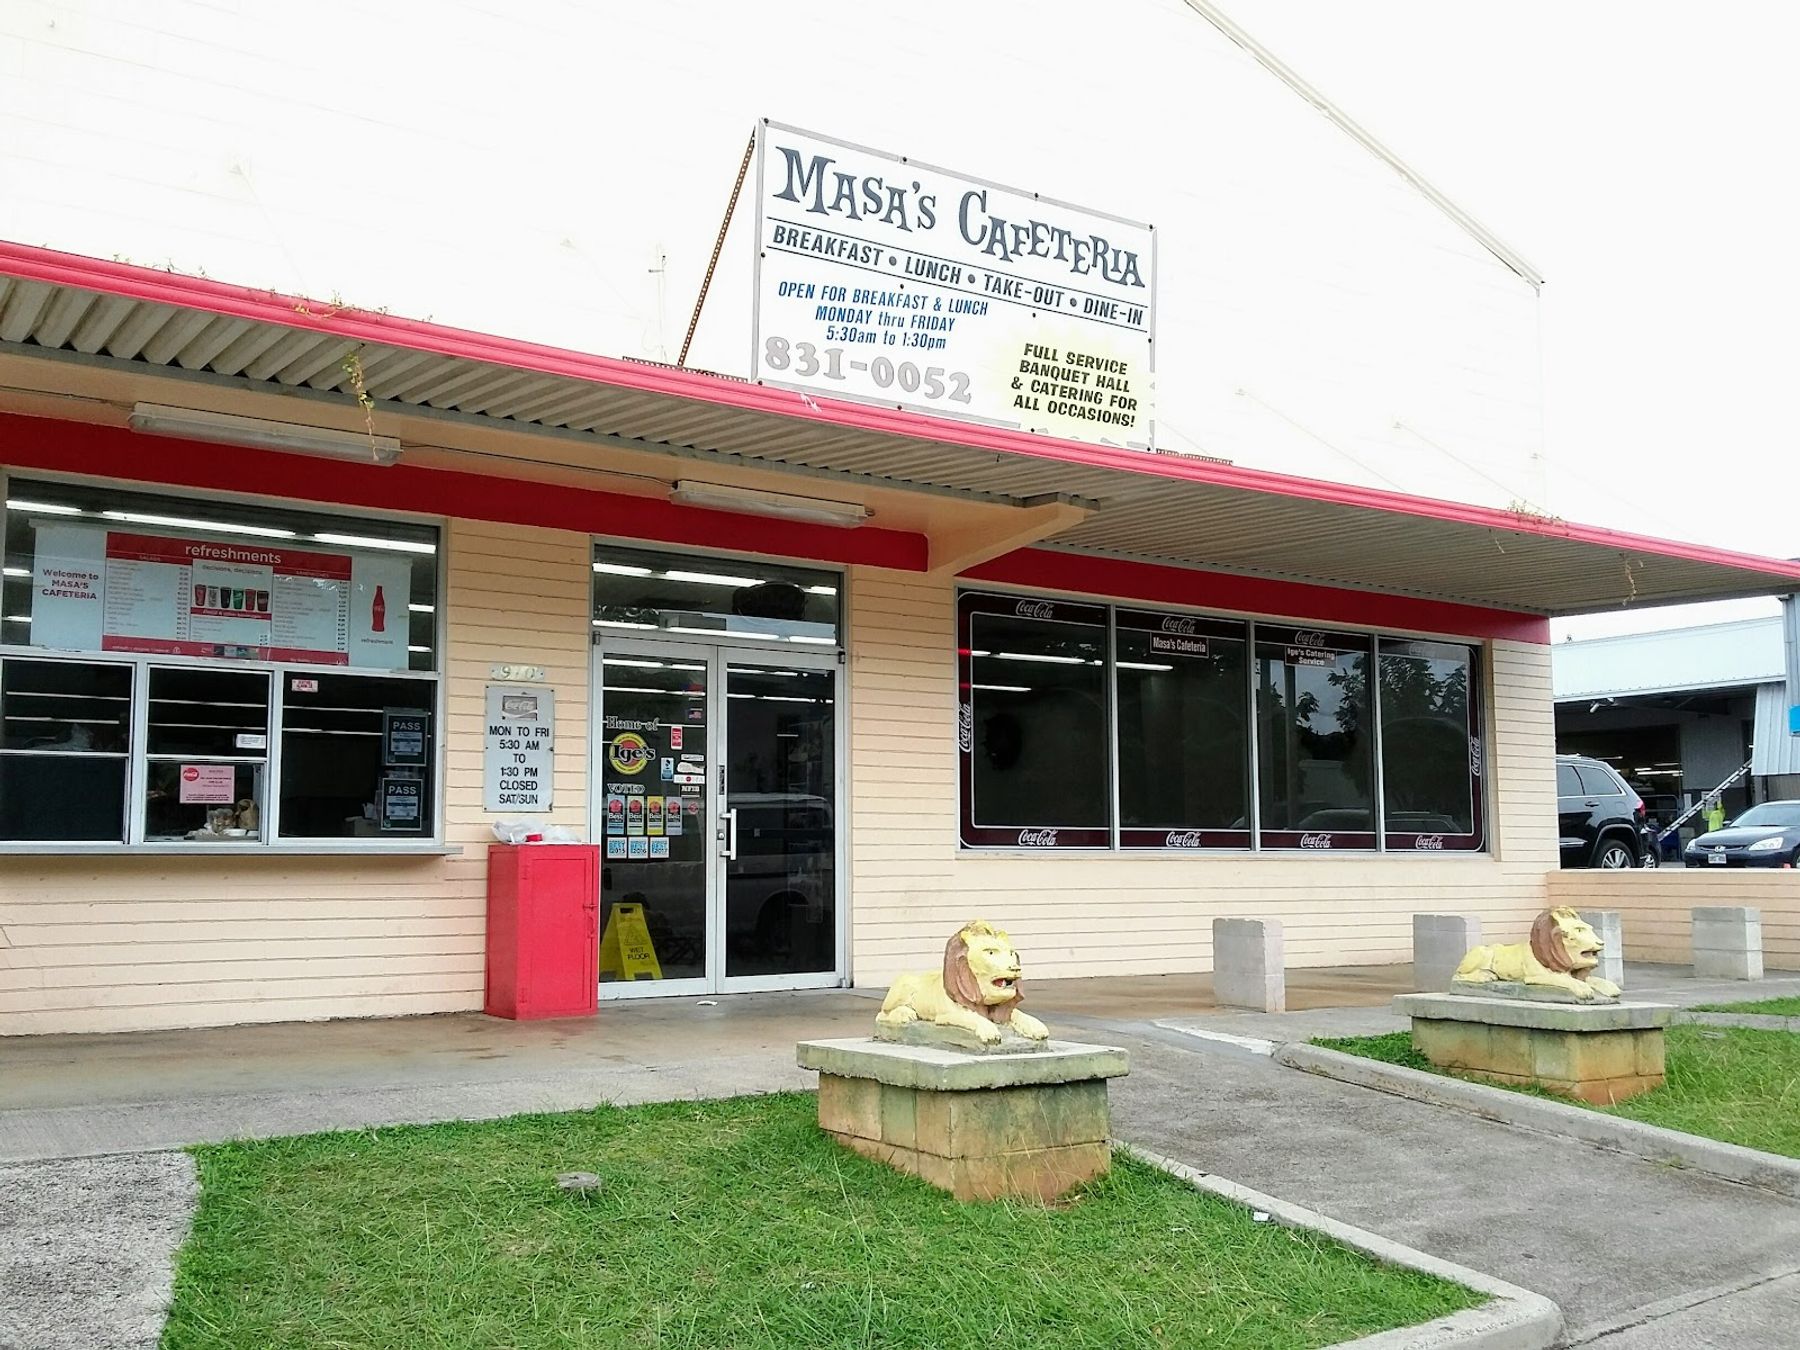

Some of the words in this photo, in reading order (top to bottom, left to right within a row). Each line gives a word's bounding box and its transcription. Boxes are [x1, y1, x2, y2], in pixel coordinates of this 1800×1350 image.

[772, 146, 937, 233] MASA'S
[958, 189, 1146, 288] CAFETERIA
[772, 224, 884, 267] BREAKFAST
[904, 256, 962, 285] LUNCH
[983, 273, 1065, 308] TAKE-OUT
[1083, 296, 1144, 326] DINE-IN
[778, 281, 816, 300] OPEN
[821, 285, 847, 302] FOR
[852, 288, 928, 311] BREAKFAST
[933, 296, 942, 312] &
[948, 298, 989, 317] LUNCH
[815, 304, 873, 326] MONDAY
[878, 311, 905, 328] thru
[910, 314, 956, 332] FRIDAY
[826, 325, 877, 345] 5:30am
[883, 330, 896, 346] to
[902, 332, 947, 351] 1:30pm
[1023, 342, 1059, 362] FULL
[1065, 351, 1128, 376] SERVICE
[765, 336, 972, 405] 831-0052
[1019, 359, 1091, 385] BANQUET
[1096, 374, 1130, 393] HALL
[1011, 376, 1023, 390] &
[1030, 378, 1103, 405] CATERING
[1109, 394, 1138, 411] FOR
[1013, 394, 1040, 411] ALL
[1047, 400, 1136, 428] OCCASIONS!
[185, 544, 282, 564] refreshments
[42, 568, 87, 580] Welcome
[88, 570, 99, 581] to
[51, 579, 89, 590] MASA'S
[41, 588, 97, 600] CAFETERIA
[1153, 636, 1176, 651] Masa's
[1176, 639, 1206, 654] Cafeteria
[1298, 657, 1326, 667] Service
[1305, 648, 1336, 661] Catering
[392, 721, 421, 731] PASS
[489, 725, 512, 736] MON
[517, 726, 530, 737] TO
[535, 727, 550, 737] FRI
[606, 715, 642, 729] Home
[645, 717, 660, 731] of
[499, 739, 520, 750] 5:30
[525, 740, 540, 750] AM
[513, 753, 526, 763] TO
[611, 743, 656, 763] Ige's
[500, 766, 519, 777] 1:30
[524, 767, 538, 777] PM
[388, 785, 417, 795] PASS
[499, 779, 538, 791] CLOSED
[499, 793, 538, 805] SAT/SUN
